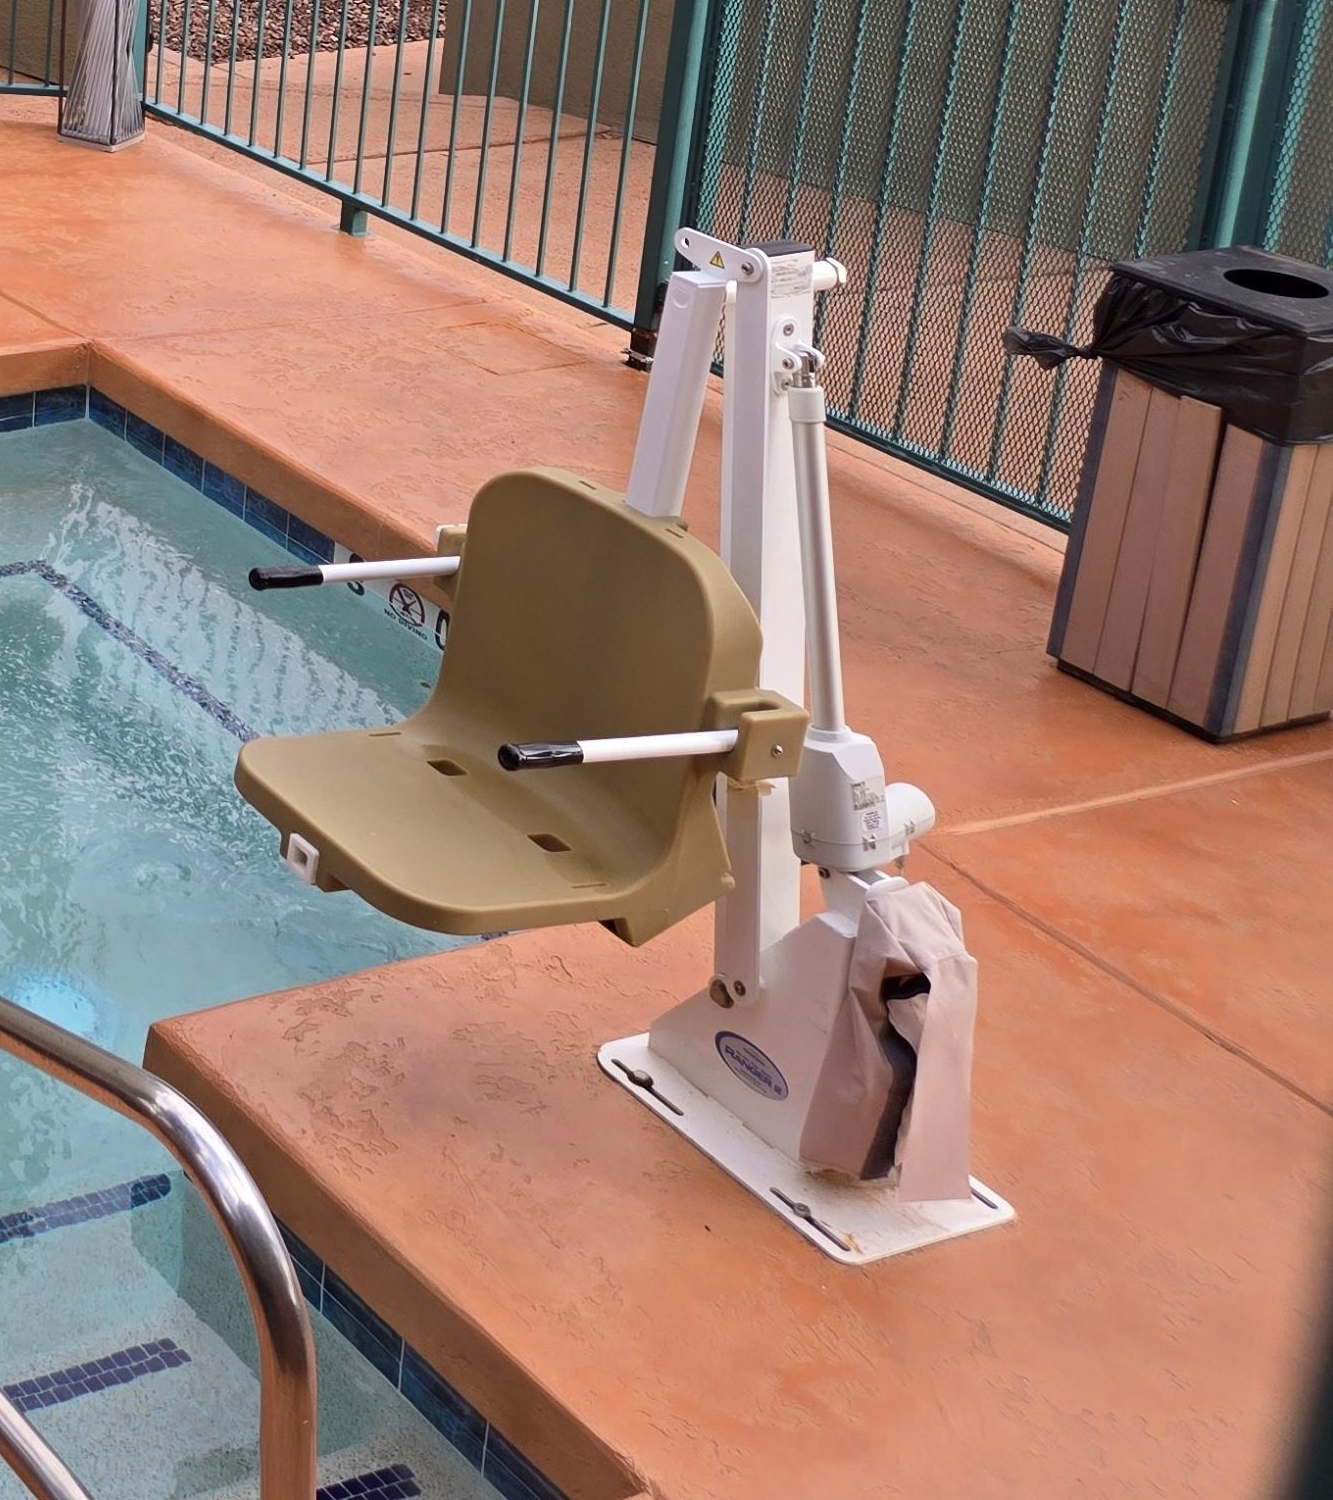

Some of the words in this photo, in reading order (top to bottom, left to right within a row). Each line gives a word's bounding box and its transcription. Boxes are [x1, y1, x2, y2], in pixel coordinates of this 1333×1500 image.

[384, 608, 396, 620] NO
[399, 620, 428, 640] DIVING
[725, 1045, 772, 1087] RANGER
